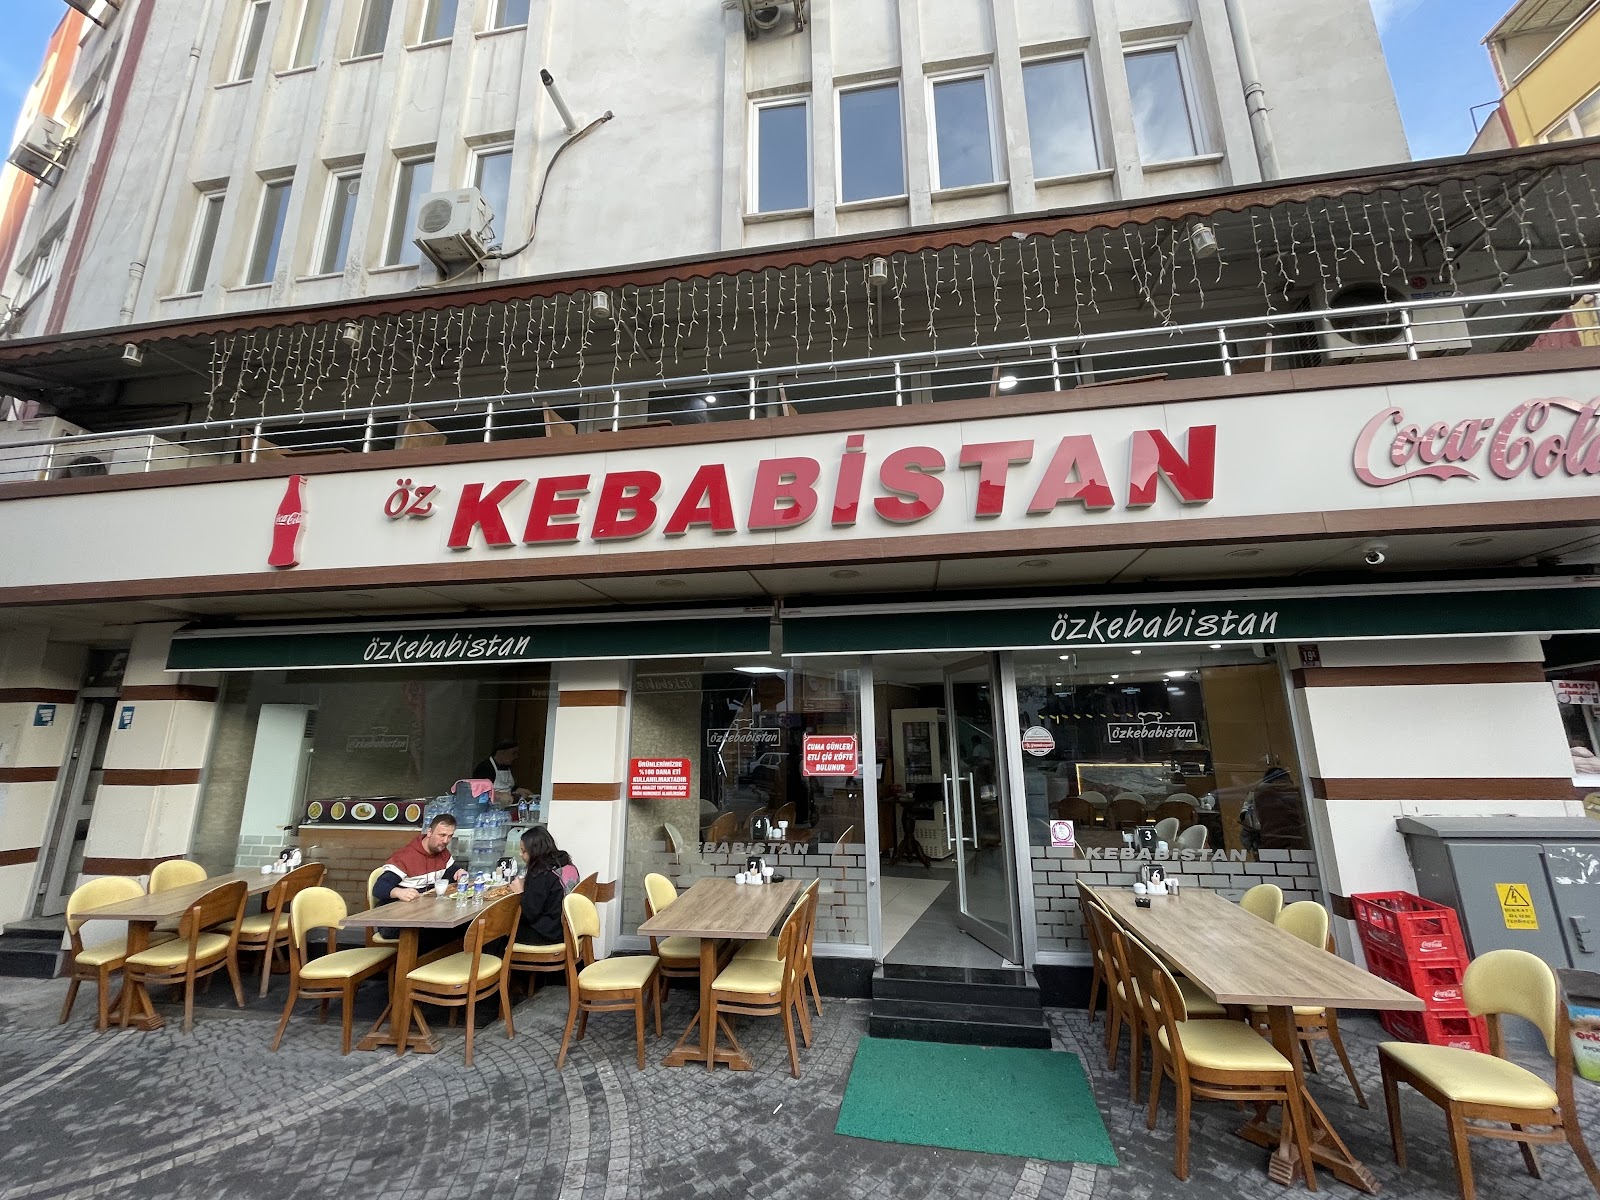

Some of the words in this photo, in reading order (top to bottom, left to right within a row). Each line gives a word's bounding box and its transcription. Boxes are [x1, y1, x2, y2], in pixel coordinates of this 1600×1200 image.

[1051, 608, 1278, 642] özkebabistan
[363, 633, 531, 662] özkebabistan
[1112, 725, 1194, 738] özkebabistan
[710, 731, 778, 744] özkebabistan
[834, 752, 854, 761] KÖFTE
[754, 819, 762, 829] 4
[1144, 830, 1152, 841] 3
[750, 861, 757, 871] 7
[1153, 869, 1160, 879] 6
